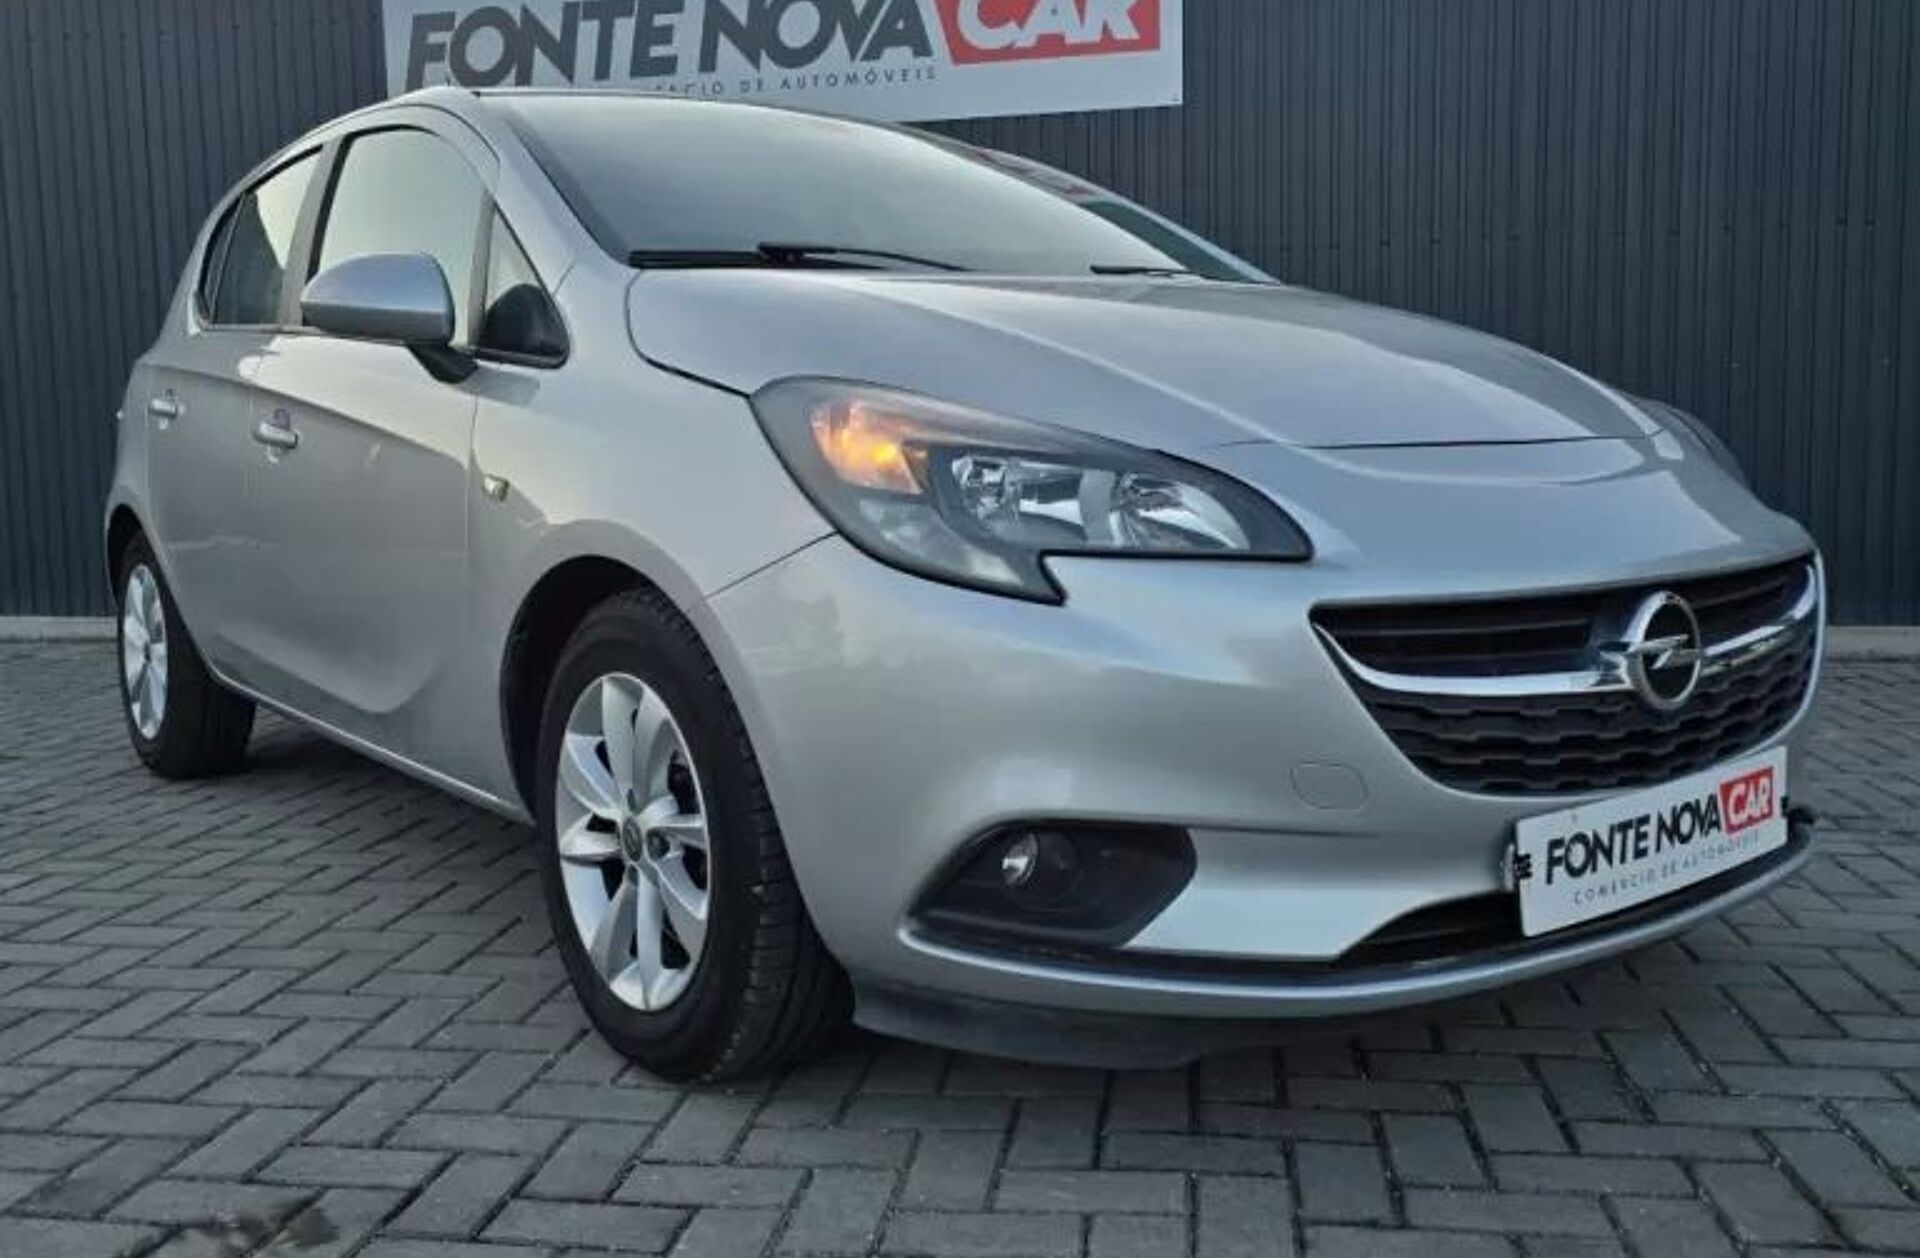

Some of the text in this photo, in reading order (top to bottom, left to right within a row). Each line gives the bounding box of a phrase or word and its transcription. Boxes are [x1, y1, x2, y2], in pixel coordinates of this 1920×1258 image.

[405, 0, 1141, 93] FONTE NOVA CAR
[1545, 776, 1769, 885] FONTE NOVA CAR
